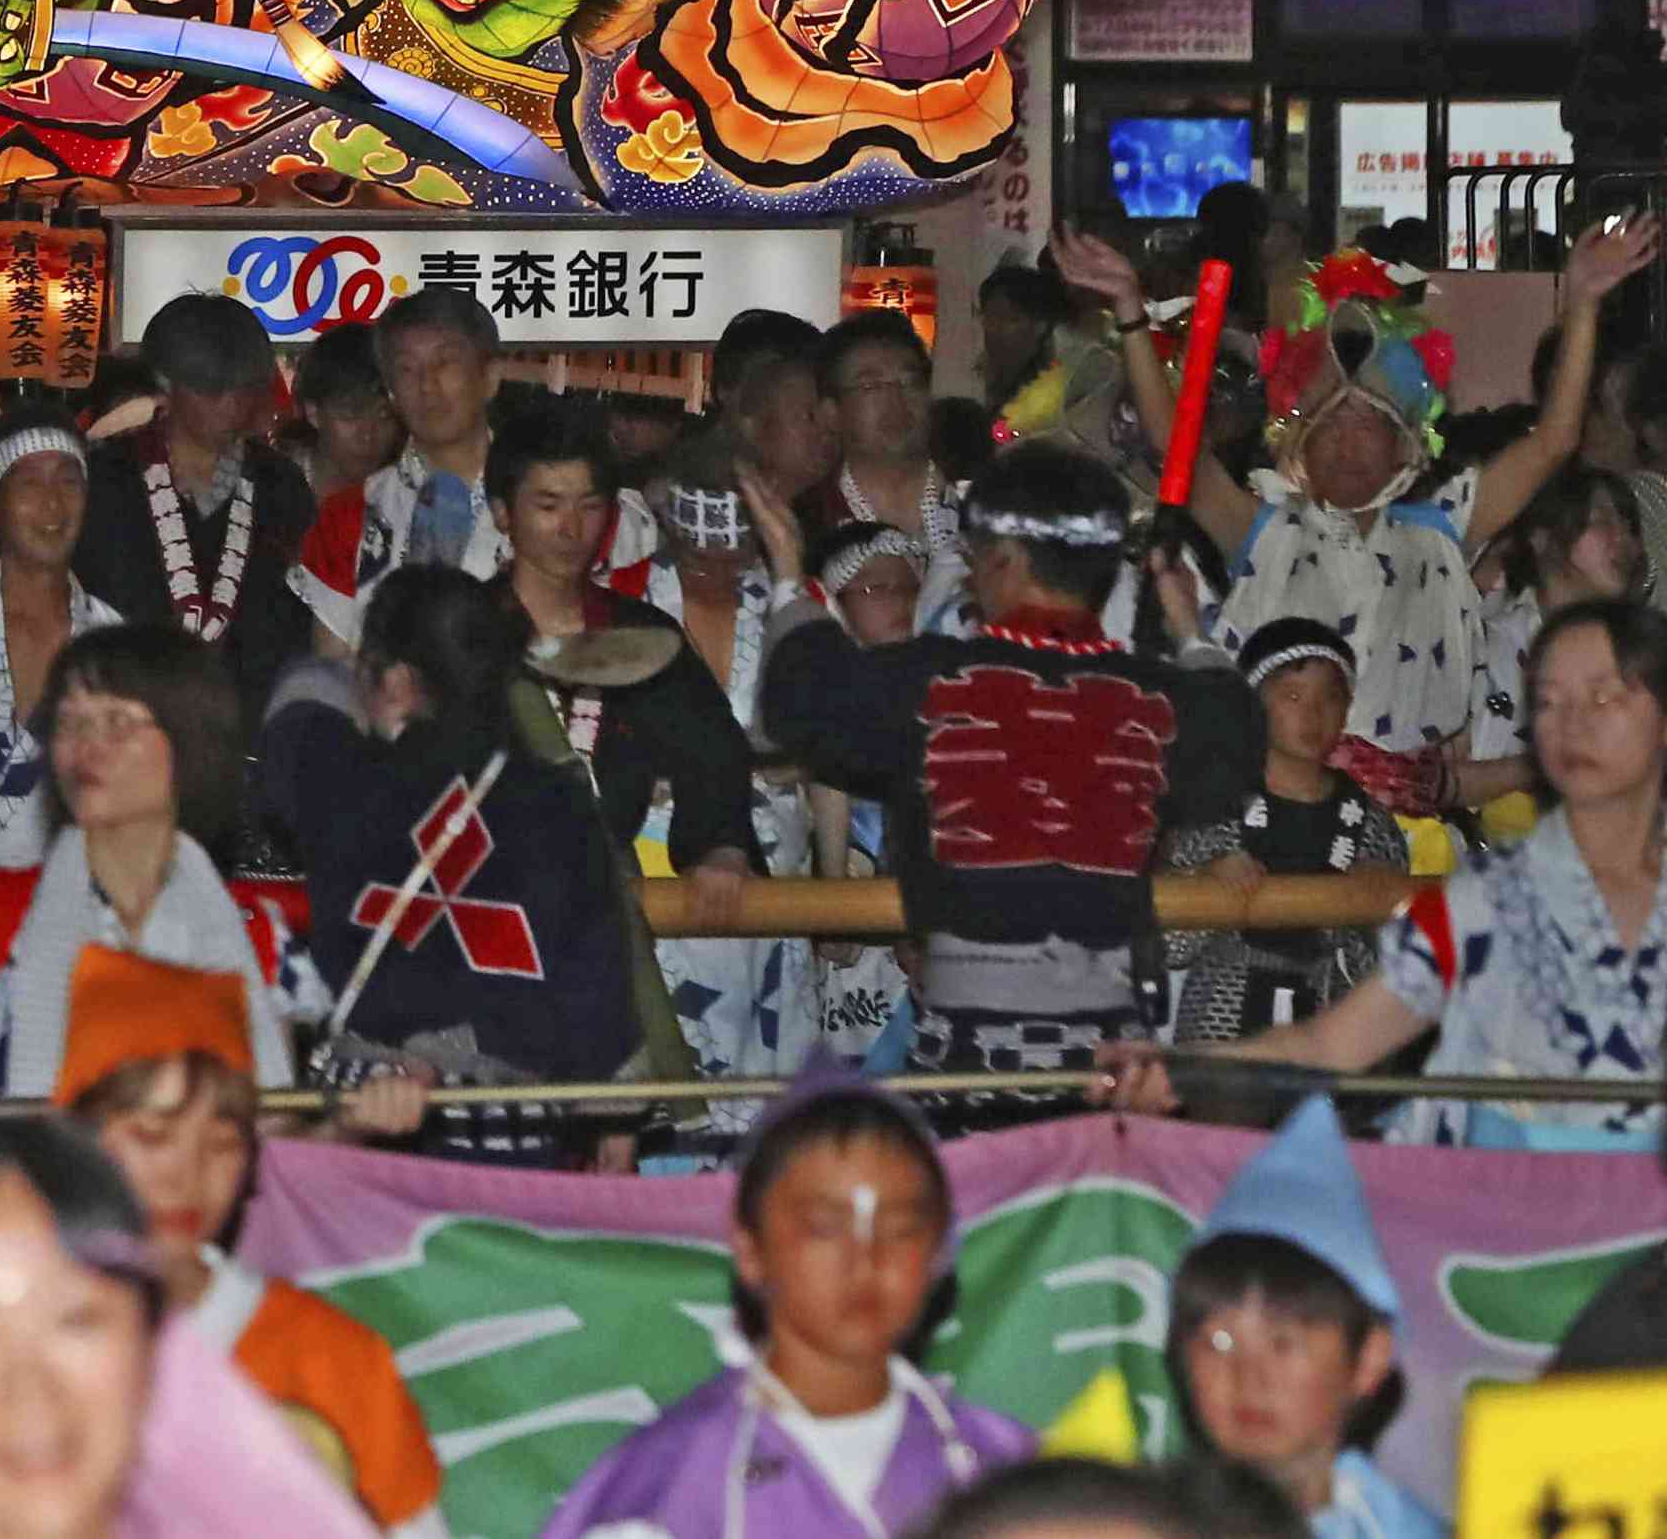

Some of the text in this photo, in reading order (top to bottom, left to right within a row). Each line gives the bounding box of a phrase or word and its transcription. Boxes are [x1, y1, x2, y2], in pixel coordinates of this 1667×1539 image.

[6, 230, 45, 367] 青森菱友会
[58, 241, 100, 379] 青森菱友会
